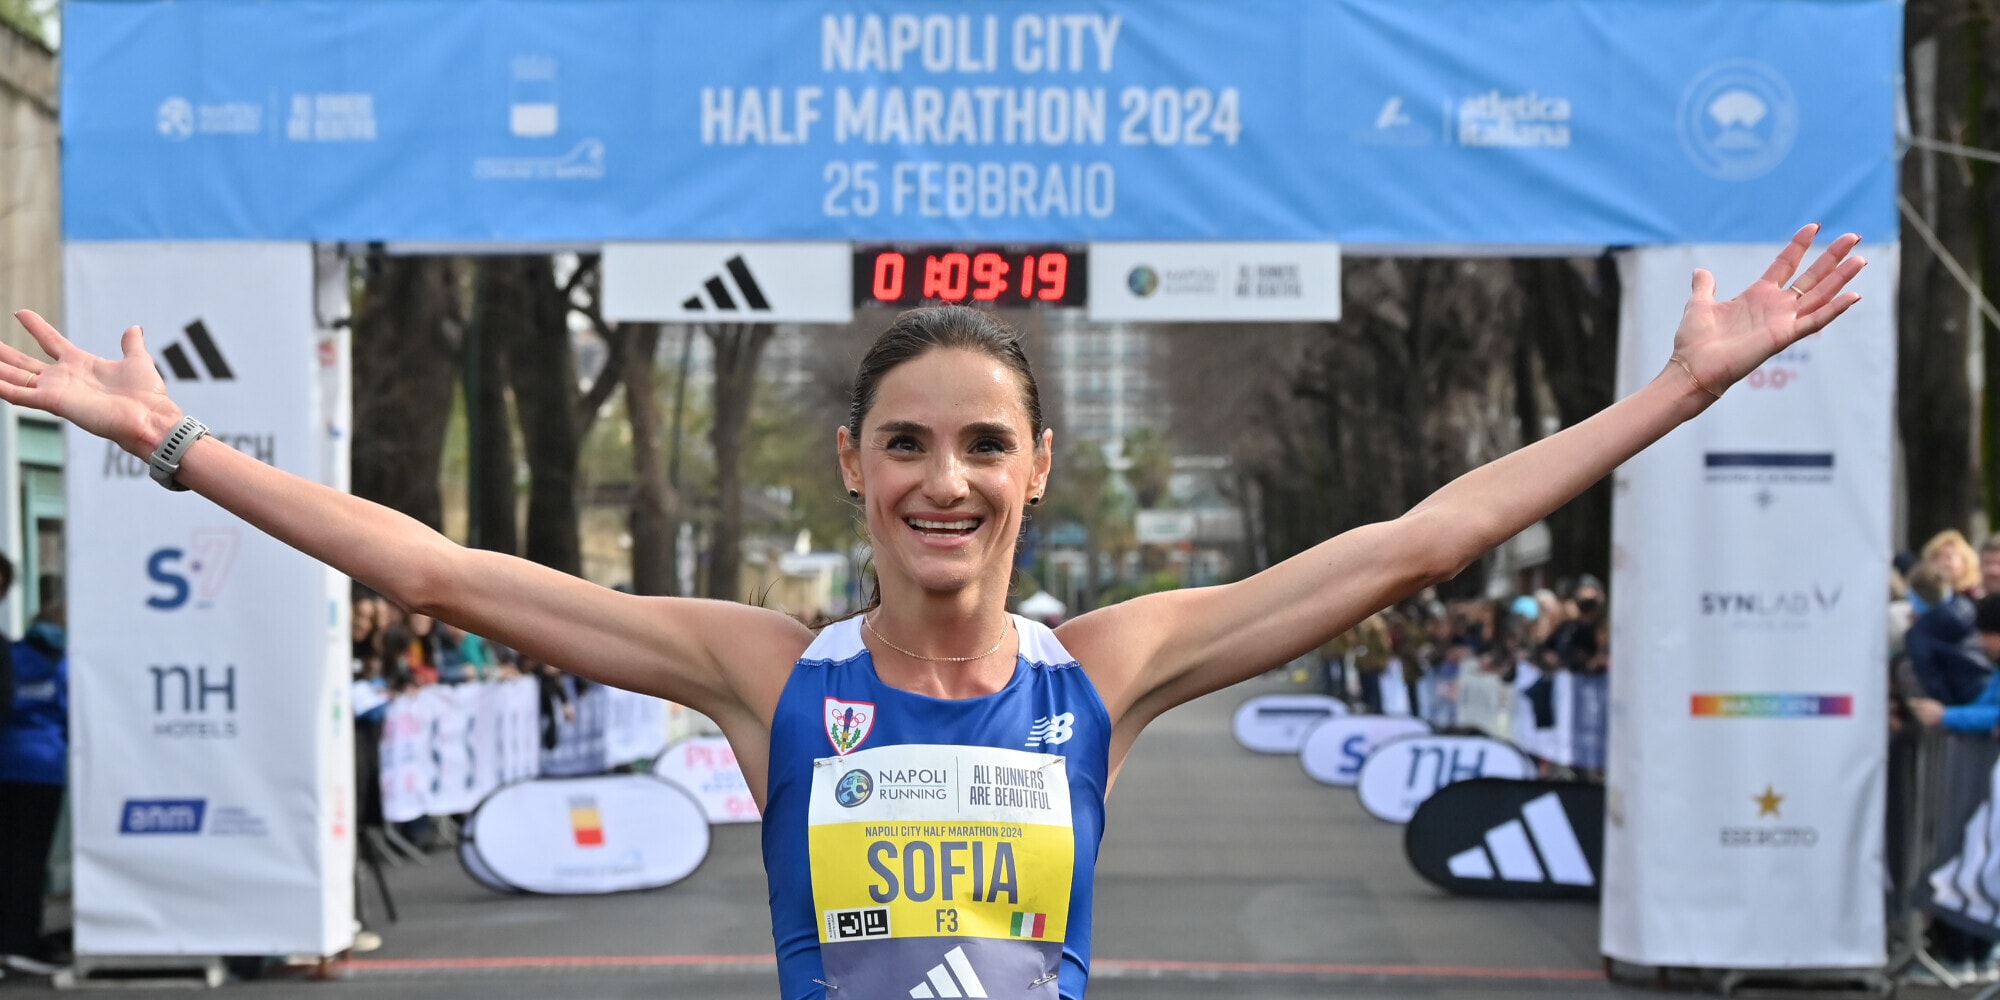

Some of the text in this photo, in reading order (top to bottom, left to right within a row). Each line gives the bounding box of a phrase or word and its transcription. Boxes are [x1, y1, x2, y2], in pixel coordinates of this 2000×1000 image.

[821, 13, 1122, 73] NAPOLI CITY
[701, 85, 1241, 146] HALF MARATHON 2024
[822, 160, 1116, 218] 25 FEBBRAIO
[879, 769, 947, 784] NAPOLI
[973, 764, 1045, 790] ALL RUNNERS
[879, 788, 947, 801] RUNNING
[969, 786, 1052, 810] ARE BEAUTIFUL
[865, 825, 1023, 839] NAPOLI CITY HALF MARATHON 2024
[867, 840, 1019, 905] SOFIA
[935, 908, 959, 933] F3
